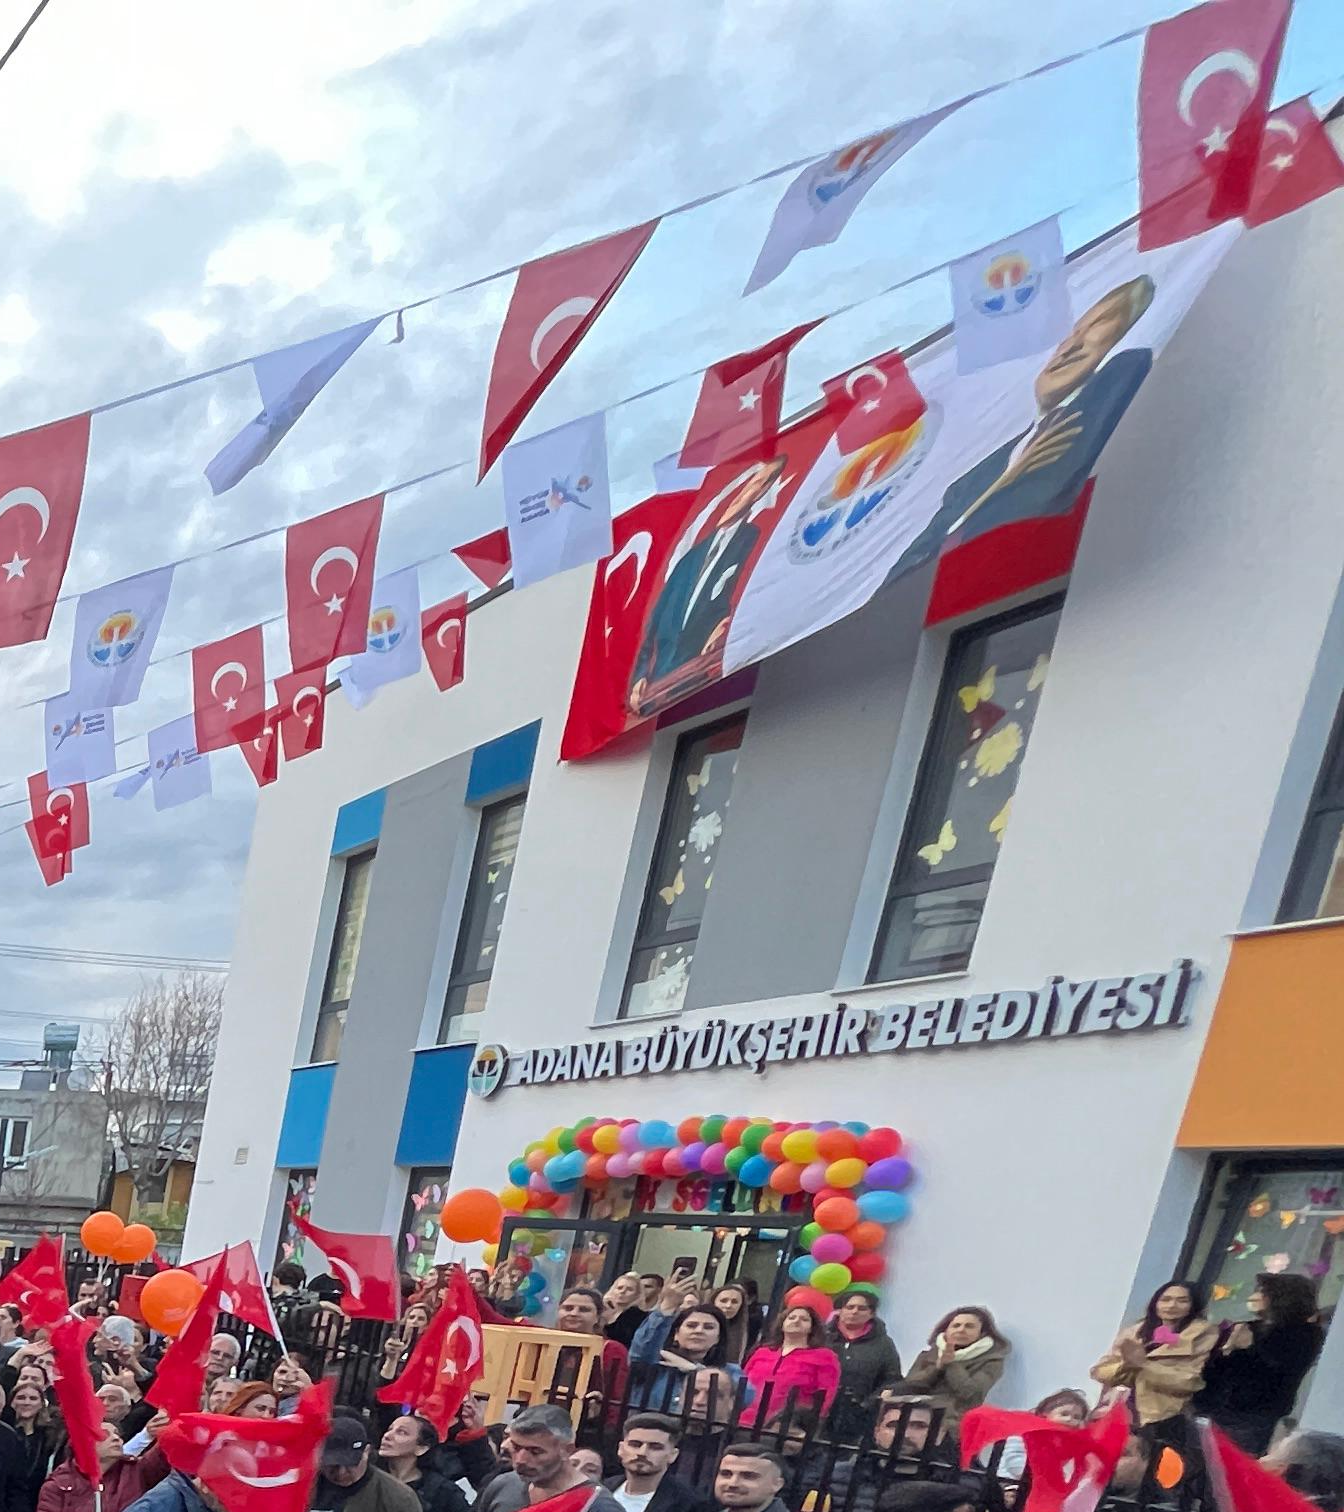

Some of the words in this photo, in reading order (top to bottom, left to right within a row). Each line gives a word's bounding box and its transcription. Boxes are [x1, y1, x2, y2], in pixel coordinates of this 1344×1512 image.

[507, 1038, 618, 1086] ADANA
[621, 1002, 866, 1076] BÜYÜKŞEHİR
[865, 957, 1195, 1052] BELEDİYESİ
